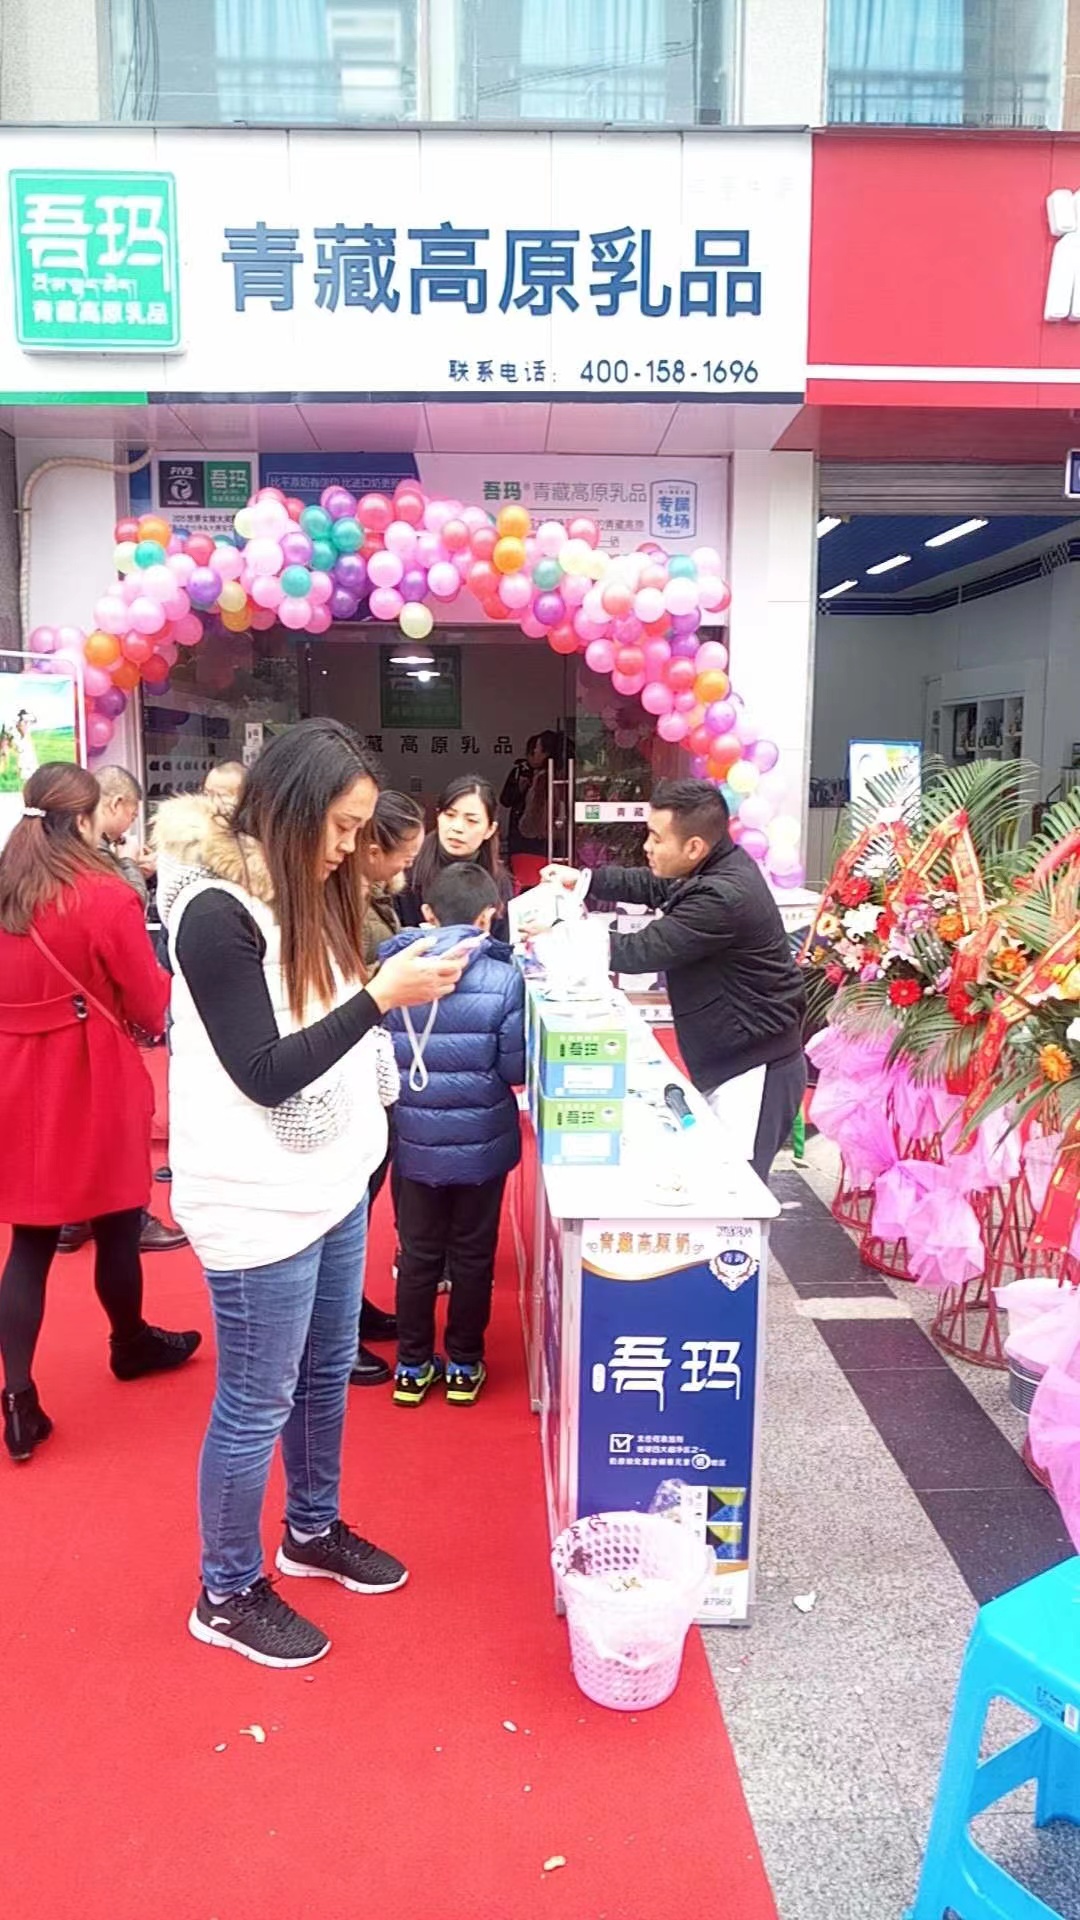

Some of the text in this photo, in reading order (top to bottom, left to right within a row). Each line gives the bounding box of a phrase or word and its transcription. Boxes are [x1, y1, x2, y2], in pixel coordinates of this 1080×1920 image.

[20, 193, 170, 293] 吾玛
[221, 221, 762, 318] 青藏高原乳品
[33, 299, 168, 325] 青藏高原乳品
[580, 359, 760, 383] 400-158-1696
[483, 481, 648, 503] 吾玛 青藏高原乳品
[657, 496, 690, 511] 专属
[657, 513, 690, 528] 牧场
[608, 1336, 741, 1411] 吾玛
